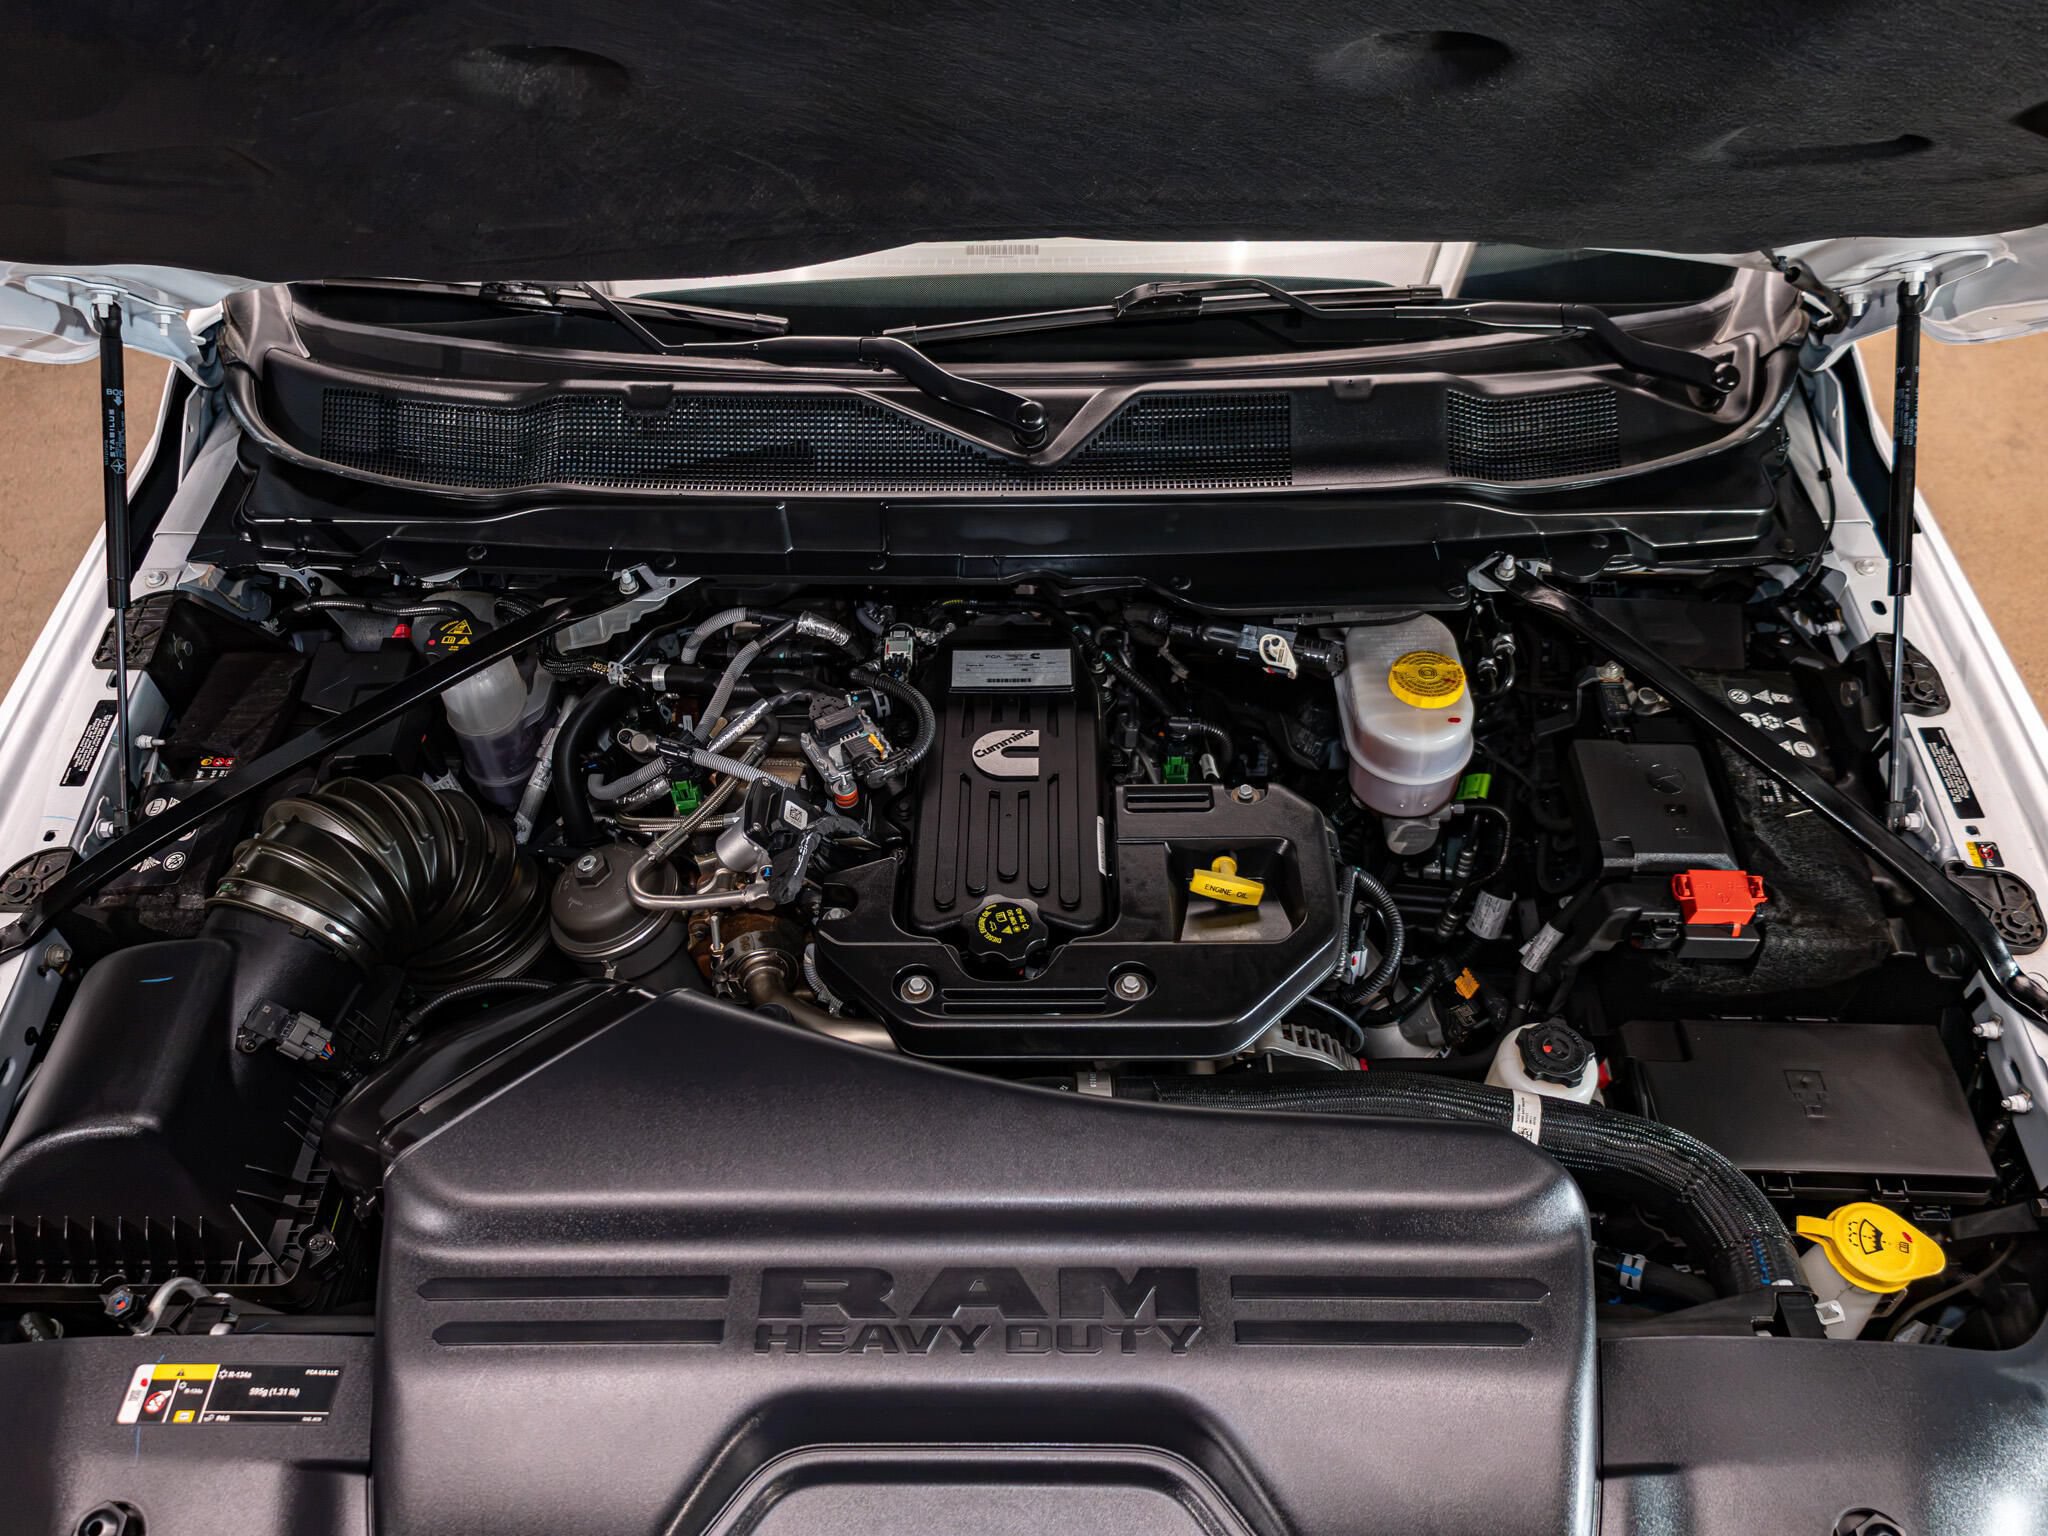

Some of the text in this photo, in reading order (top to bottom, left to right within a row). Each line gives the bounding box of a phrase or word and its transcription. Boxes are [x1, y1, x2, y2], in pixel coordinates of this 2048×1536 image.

[108, 409, 116, 457] STABILUS
[974, 729, 1034, 758] Cummins
[1204, 884, 1248, 899] ENGINE OIL
[758, 1266, 1201, 1320] RAM
[754, 1324, 1202, 1355] HEAVY DUTY
